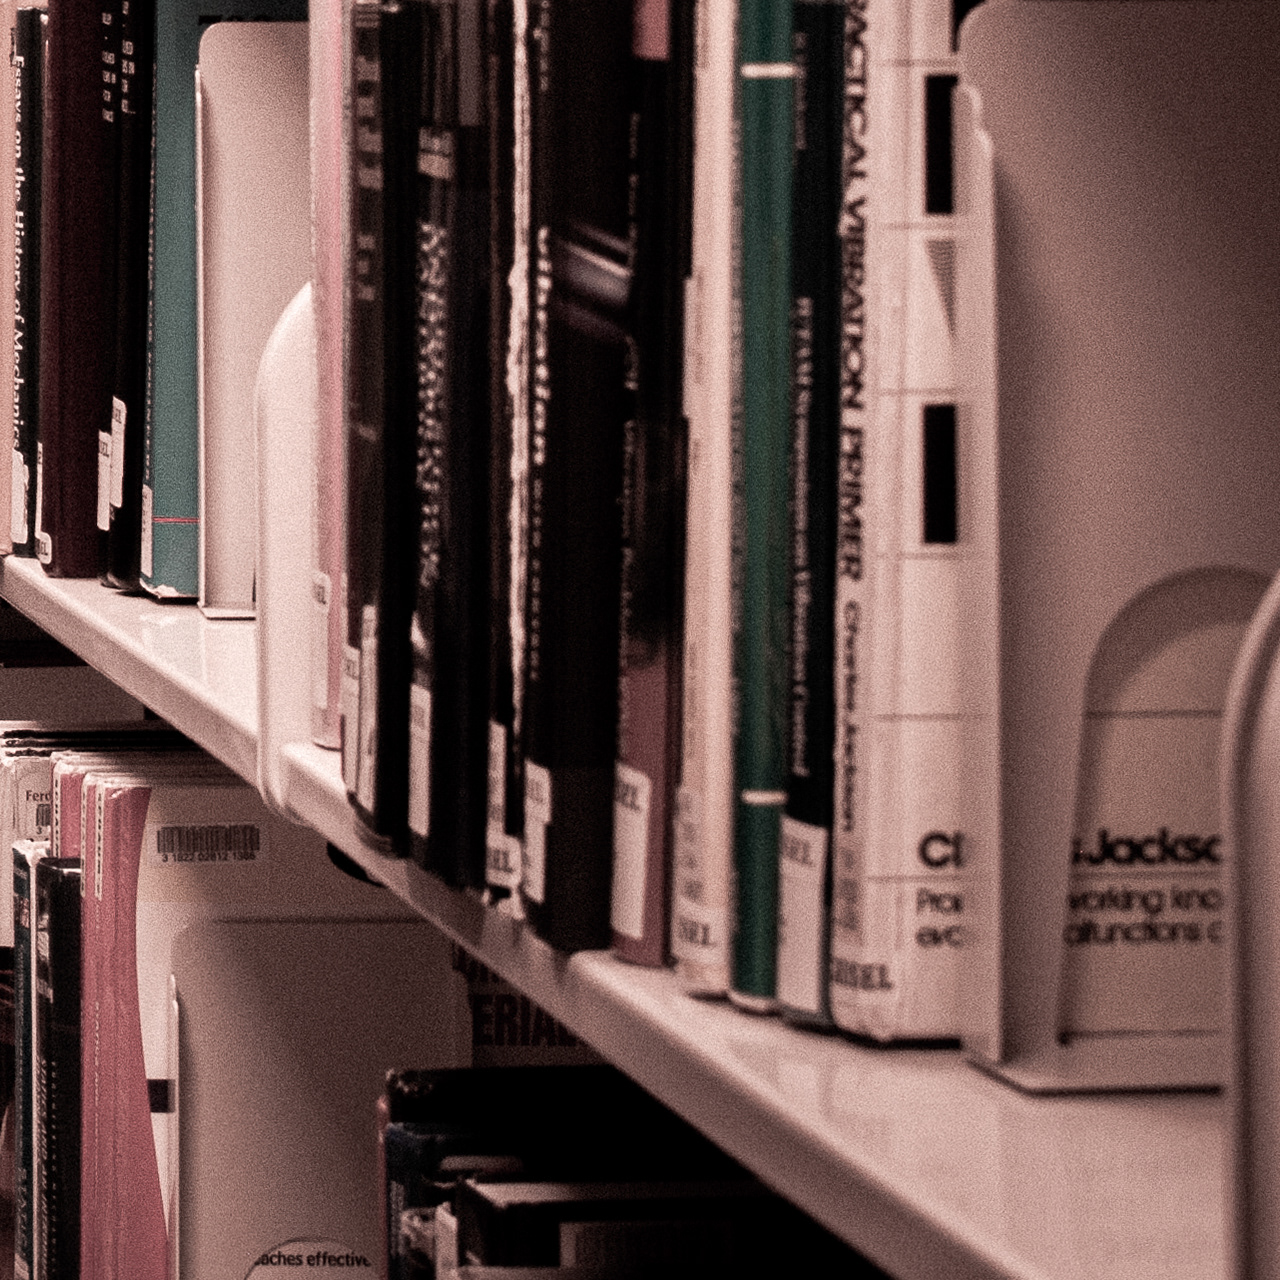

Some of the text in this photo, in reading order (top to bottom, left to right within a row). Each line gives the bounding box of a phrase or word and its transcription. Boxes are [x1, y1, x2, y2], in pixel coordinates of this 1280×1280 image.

[14, 56, 24, 133] Essays
[13, 167, 24, 202] the
[11, 208, 23, 293] History
[842, 195, 866, 411] VIBRATION
[11, 328, 23, 449] Mechanics
[840, 426, 863, 582] PRIMER
[472, 993, 578, 1046] ERIAL
